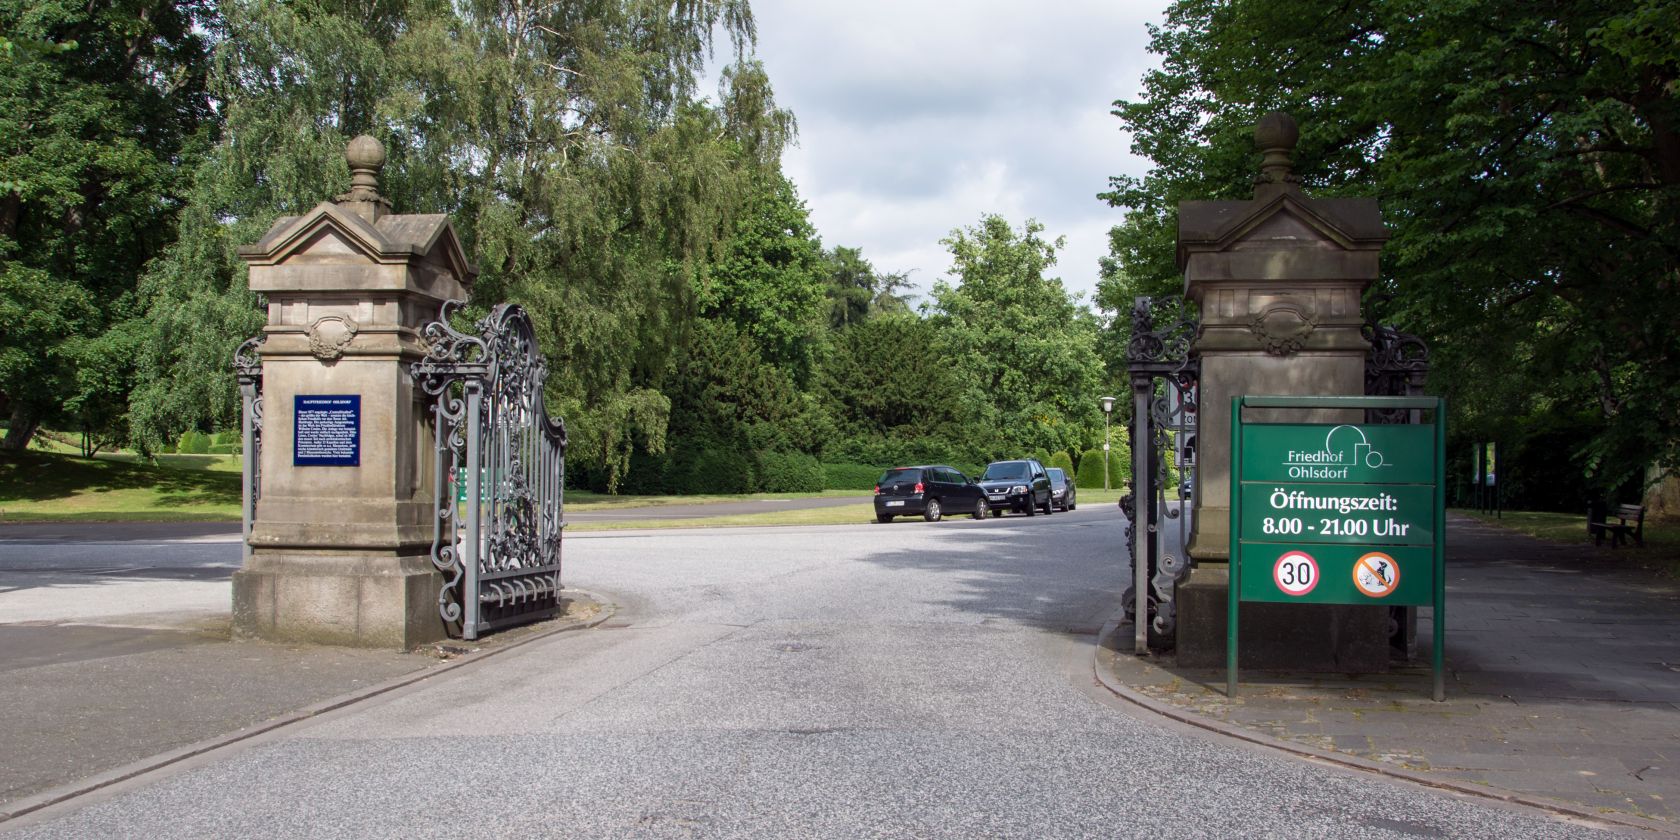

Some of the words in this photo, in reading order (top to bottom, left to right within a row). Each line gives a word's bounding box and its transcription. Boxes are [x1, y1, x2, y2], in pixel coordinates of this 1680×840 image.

[1288, 450, 1344, 463] Friedhof
[1288, 466, 1348, 479] Ohlsdorf
[1270, 488, 1397, 513] Öffnungszeit:
[1262, 517, 1303, 535] 8.00
[1320, 518, 1368, 536] 21.00
[1373, 518, 1410, 536] Uhr
[1282, 562, 1311, 586] 30
